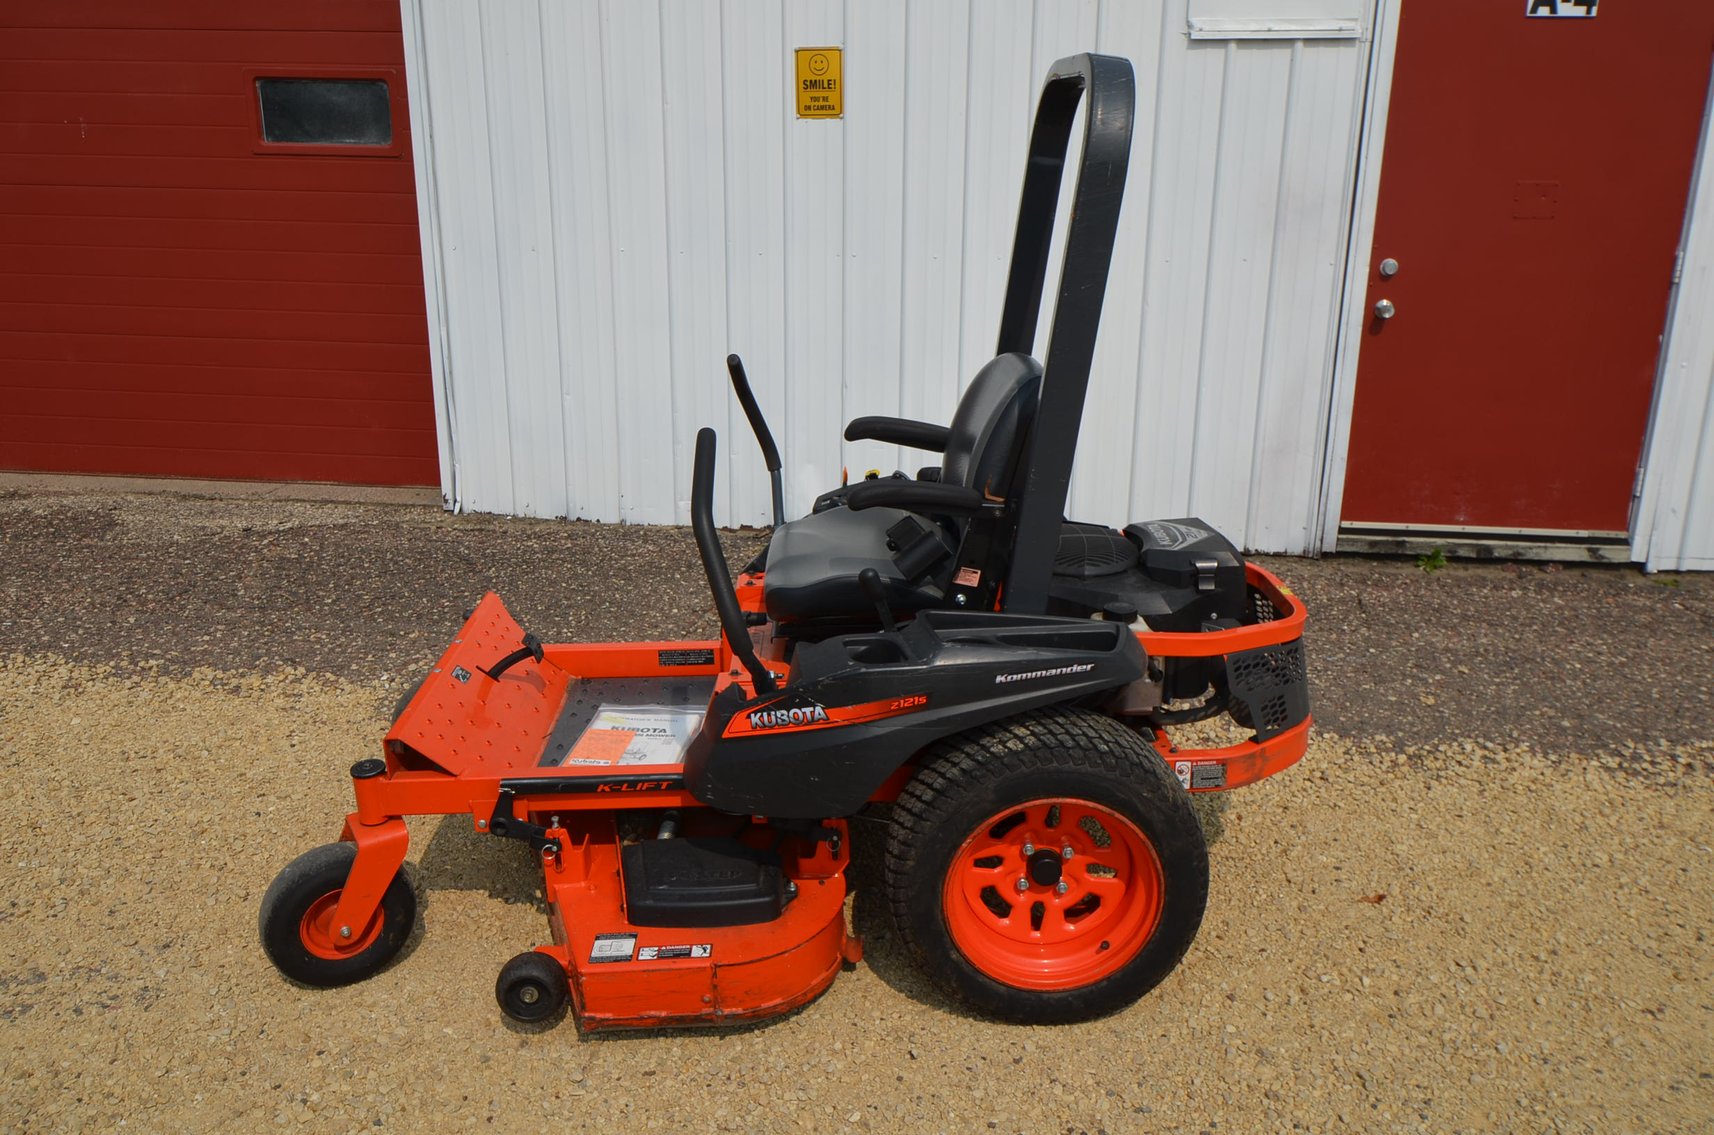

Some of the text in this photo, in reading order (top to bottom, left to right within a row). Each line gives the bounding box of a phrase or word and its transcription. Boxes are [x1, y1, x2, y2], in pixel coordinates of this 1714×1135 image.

[803, 79, 836, 90] SMILE!
[810, 95, 829, 103] YOU'RE
[996, 663, 1095, 684] Kommander
[750, 705, 829, 729] KUBOTA
[597, 781, 673, 792] K-LIFT
